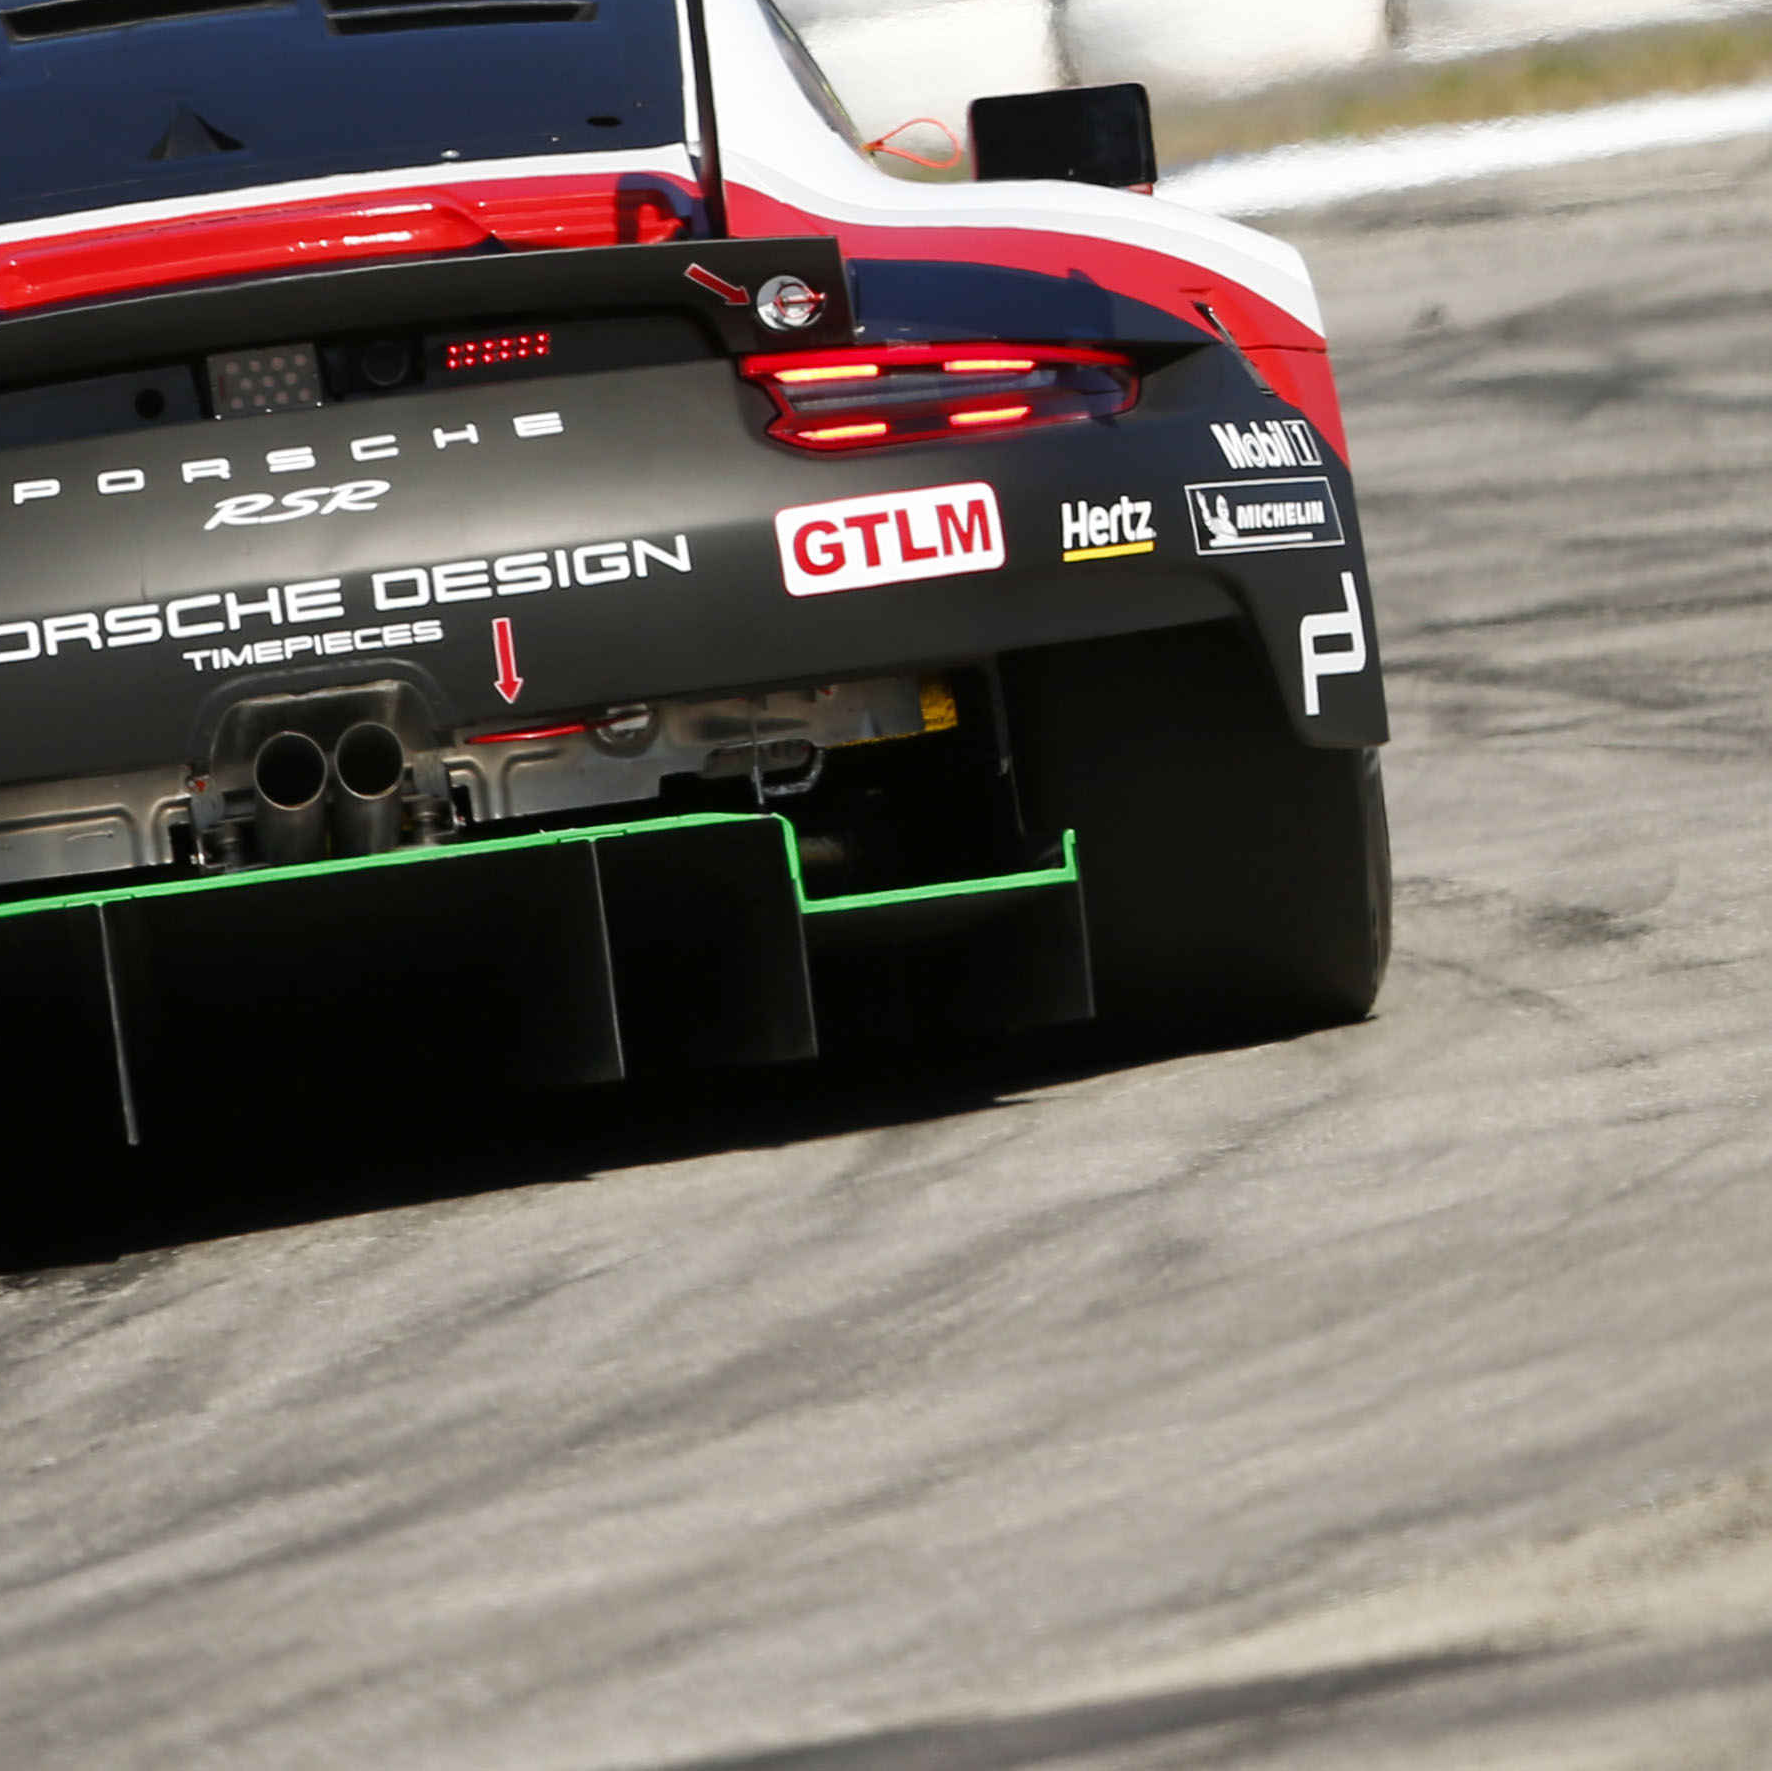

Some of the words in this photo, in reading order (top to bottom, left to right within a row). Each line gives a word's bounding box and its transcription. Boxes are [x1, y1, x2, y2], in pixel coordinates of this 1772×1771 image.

[13, 411, 563, 504] PORSCHE
[1210, 421, 1297, 470] Mobil
[203, 479, 392, 530] RSR
[1061, 494, 1156, 550] Hertz
[1235, 500, 1326, 530] MICHELIN
[793, 498, 994, 577] GTLM
[372, 534, 693, 613] DESIGN
[182, 620, 444, 671] TIMEPIECES
